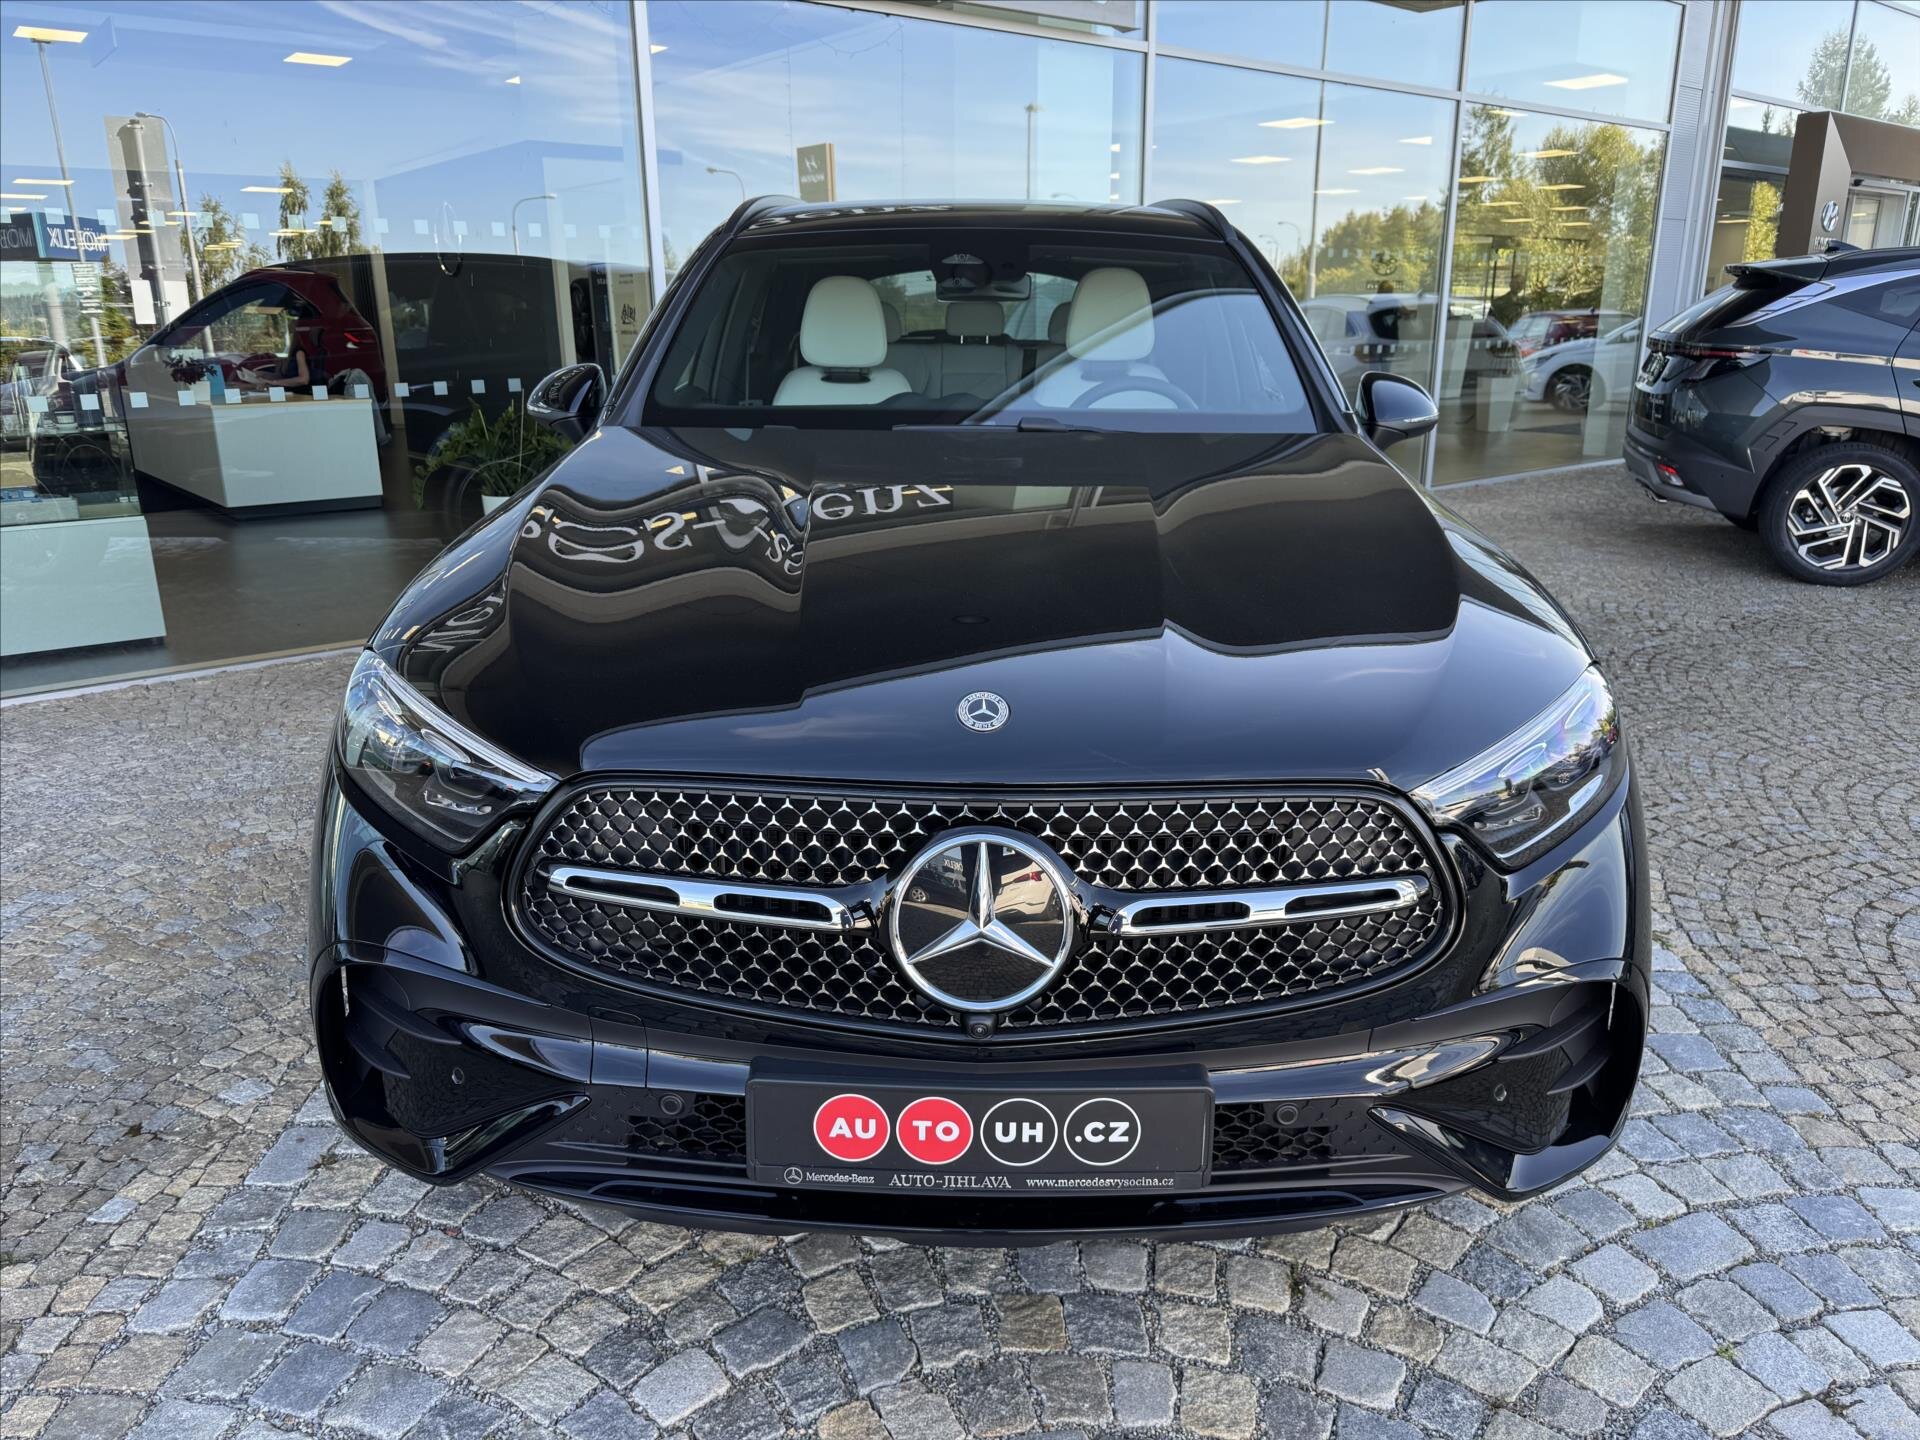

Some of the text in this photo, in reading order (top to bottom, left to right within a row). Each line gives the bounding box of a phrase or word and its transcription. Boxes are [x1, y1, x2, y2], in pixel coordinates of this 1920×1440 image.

[829, 1117, 1130, 1143] AU TO UH .CZ
[806, 1172, 1175, 1189] Mercedes-Benz AUTO-JIHLAVA www.mercedesvysocina.cz
